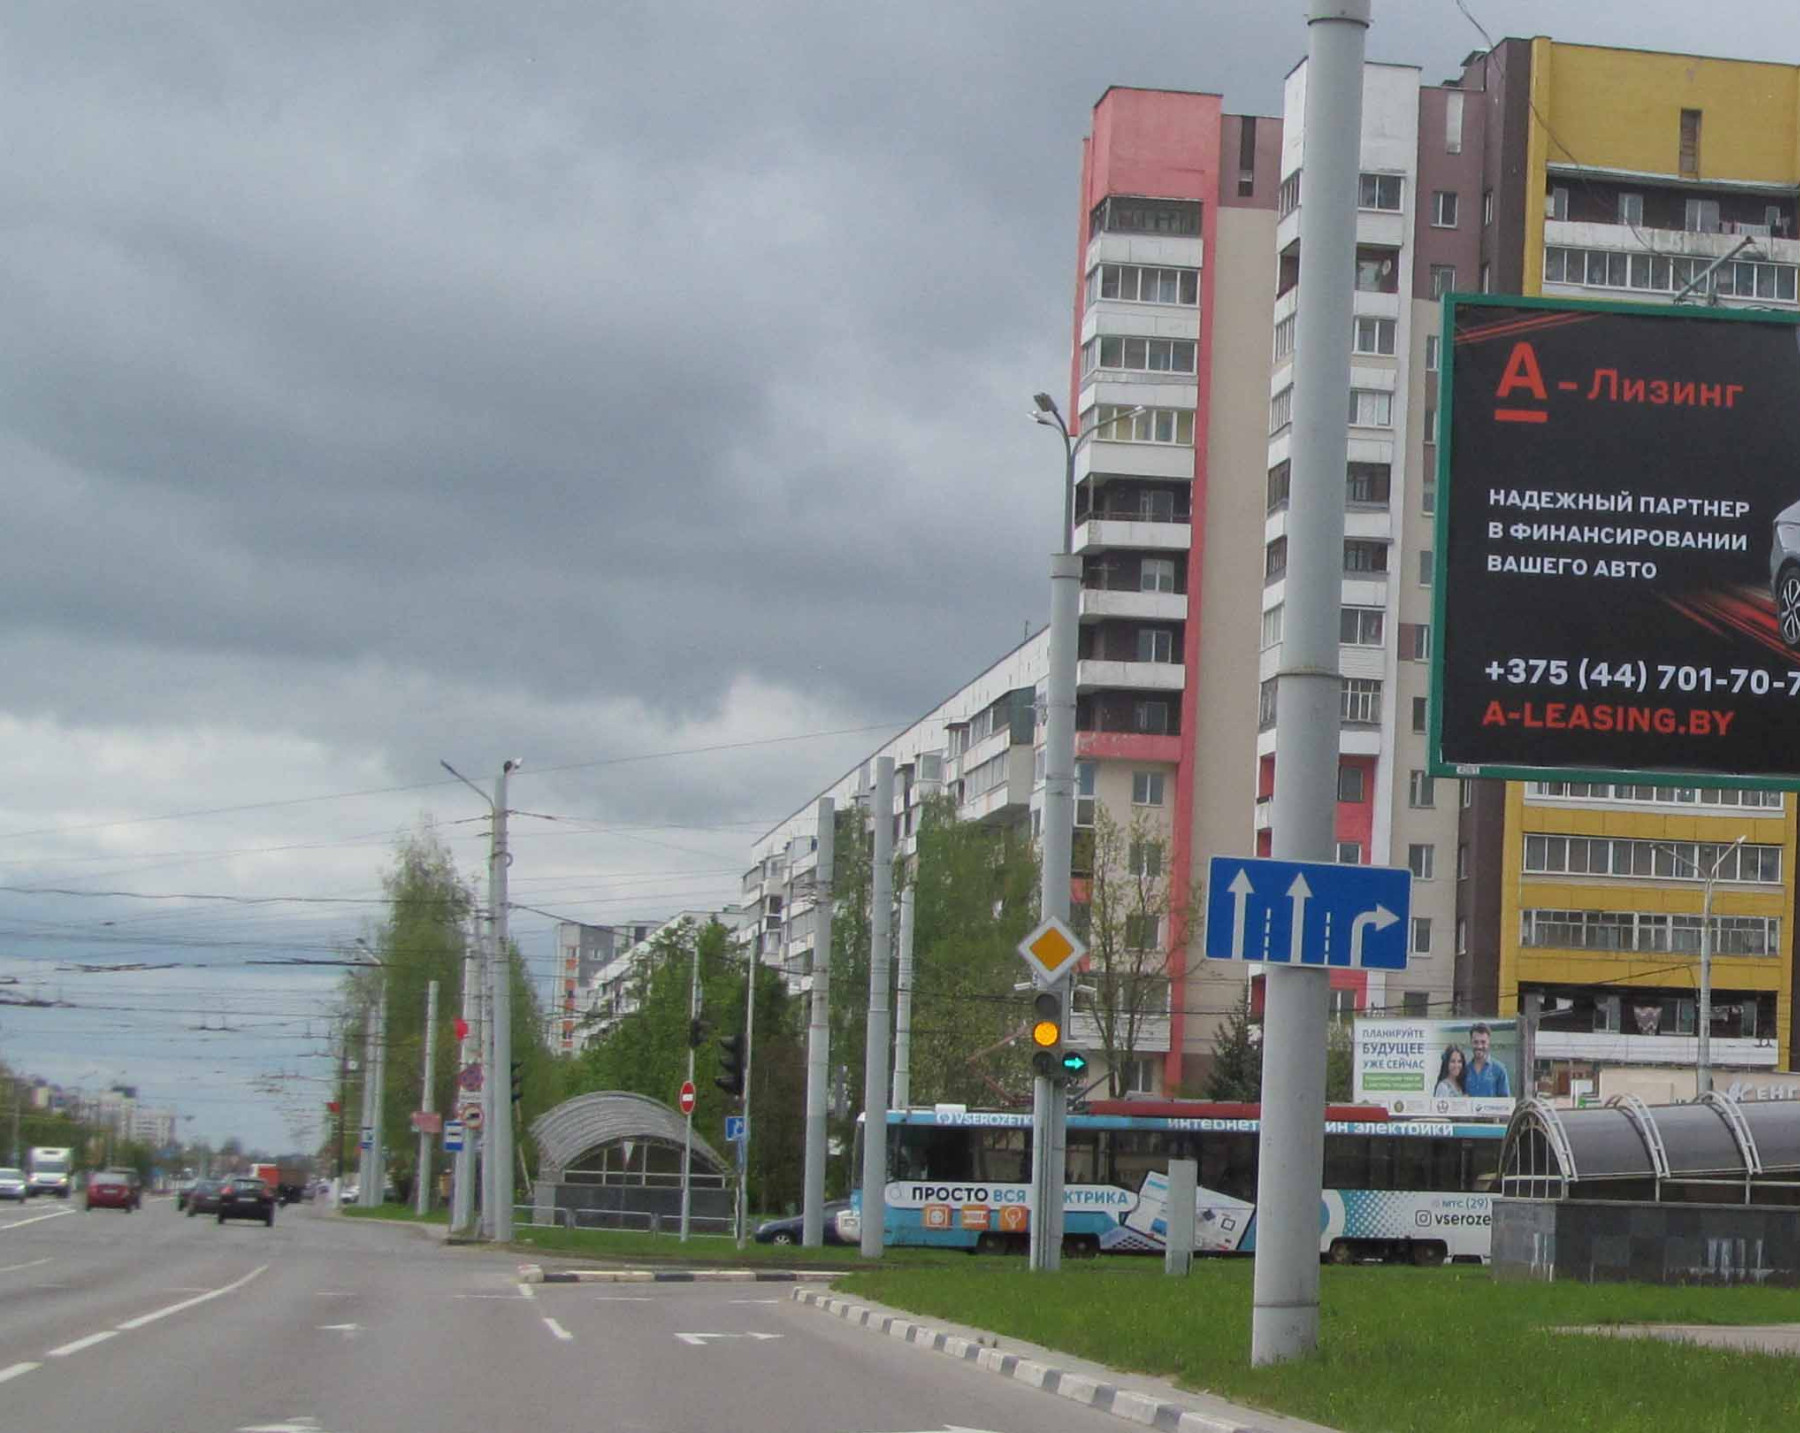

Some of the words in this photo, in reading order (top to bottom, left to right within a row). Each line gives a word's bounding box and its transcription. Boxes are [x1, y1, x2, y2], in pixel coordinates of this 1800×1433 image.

[1587, 368, 1744, 407] Лизинг
[1488, 488, 1634, 514] НАДЕЖНЫЙ
[1639, 496, 1751, 519] ПАРТНЕР
[1487, 521, 1504, 540] В
[1509, 522, 1748, 552] ФИНАНСИРОВАНИИ
[1486, 554, 1588, 577] ВАШЕГО
[1593, 559, 1658, 580] АВТО
[1484, 658, 1569, 687] +375
[1578, 657, 1648, 694] (44)
[1482, 700, 1736, 736] A-LEASING.BY
[1362, 1026, 1425, 1039] ПЛАНИРУЙТЕ
[1362, 1043, 1425, 1057] БУДУЩЕЕ
[1362, 1059, 1383, 1070] УЖЕ
[1386, 1057, 1425, 1070] СЕЙЧАС
[955, 1111, 1034, 1126] VSEROZETK
[1167, 1118, 1261, 1132] интернет
[911, 1186, 989, 1202] ПРОСТО
[993, 1189, 1027, 1204] ВСЯ
[1063, 1190, 1129, 1204] КТРИКА
[1465, 1197, 1489, 1211] (29)
[1435, 1214, 1491, 1226] vseroze
